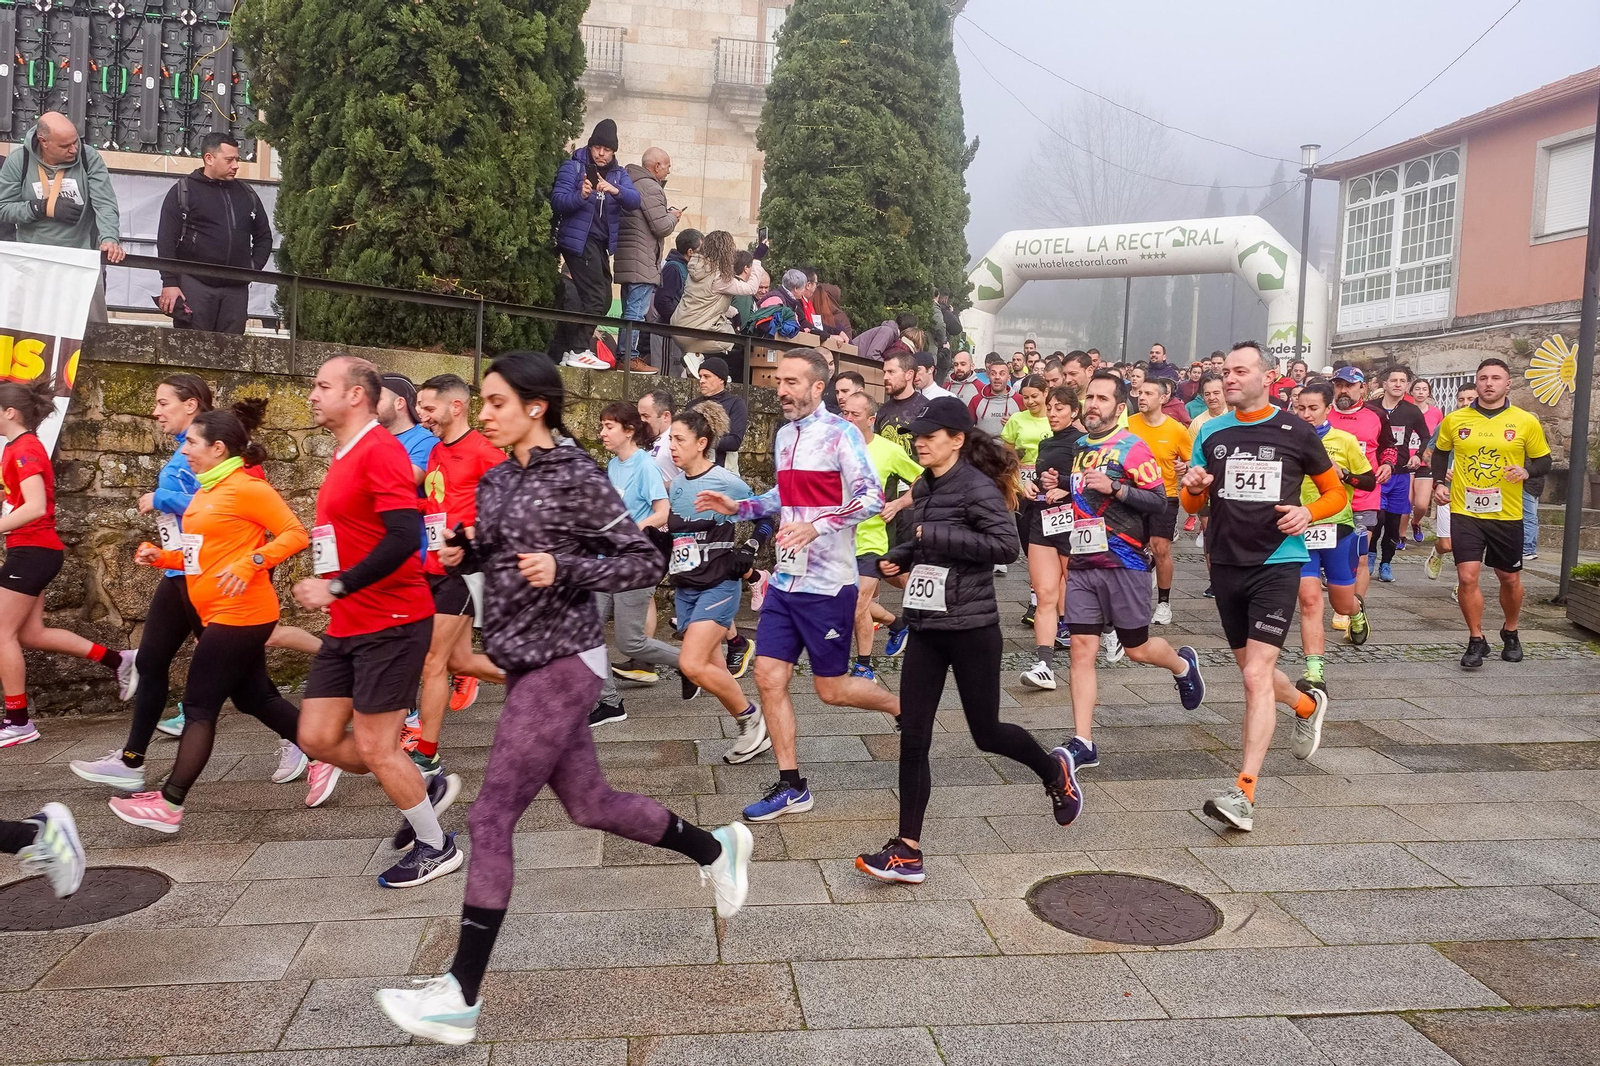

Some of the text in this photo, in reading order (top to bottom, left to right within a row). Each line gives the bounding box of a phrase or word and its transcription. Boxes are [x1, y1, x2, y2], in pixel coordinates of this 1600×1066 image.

[1015, 237, 1075, 256] HOTEL
[1086, 236, 1109, 253] LA
[1015, 254, 1128, 269] www.hotelrectoral.com
[1235, 473, 1266, 490] 541
[1475, 496, 1490, 507] 40
[1051, 512, 1073, 527] 225
[1077, 529, 1092, 544] 70
[1305, 530, 1327, 541] 243
[780, 548, 796, 564] 24
[909, 578, 934, 598] 650
